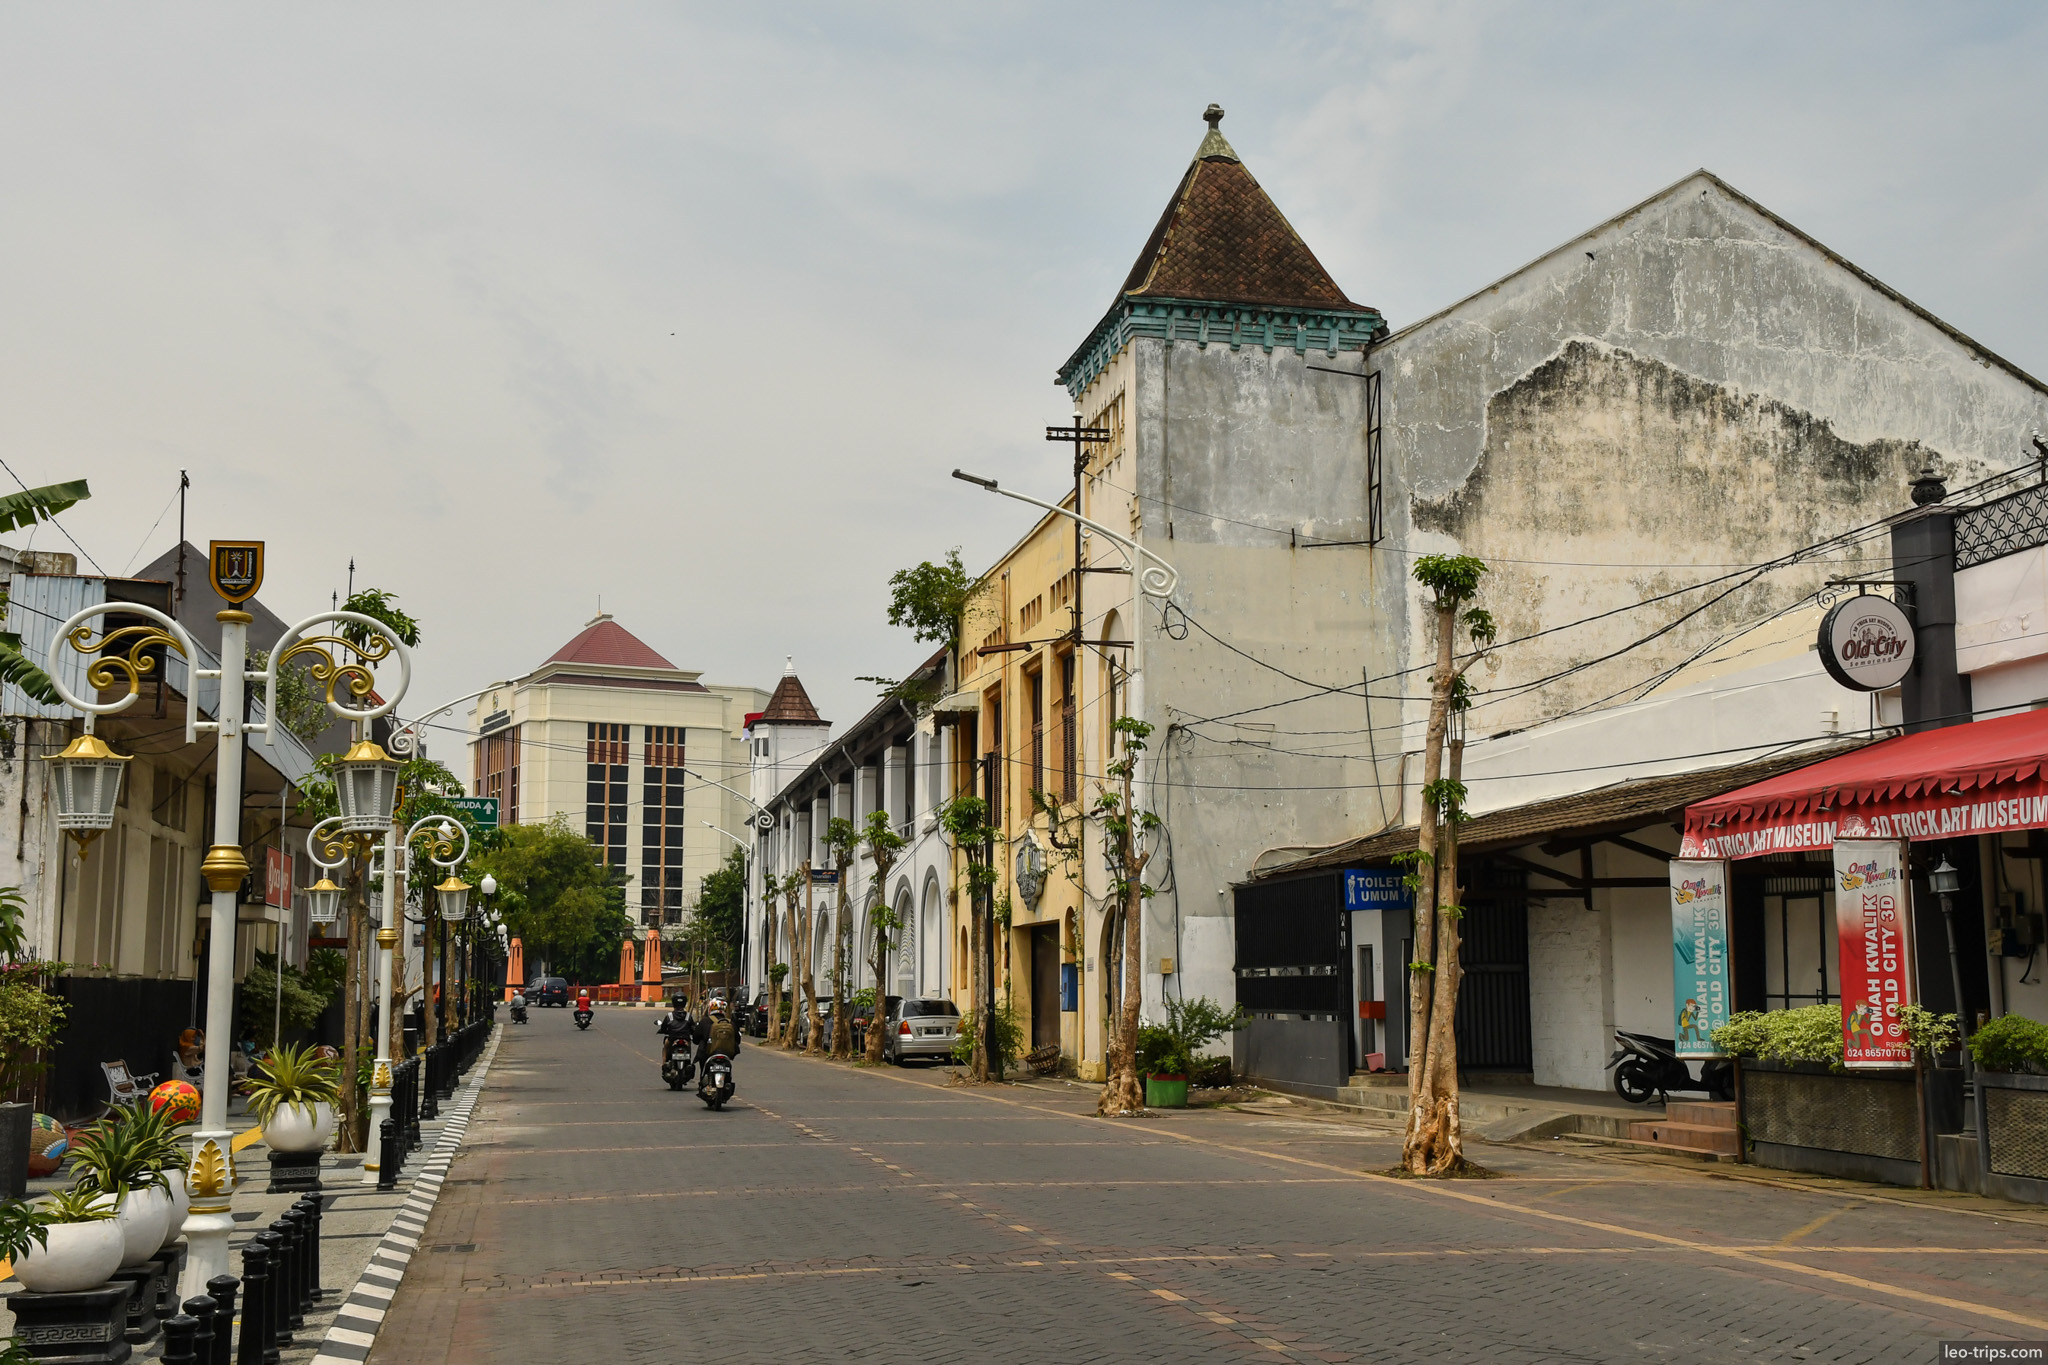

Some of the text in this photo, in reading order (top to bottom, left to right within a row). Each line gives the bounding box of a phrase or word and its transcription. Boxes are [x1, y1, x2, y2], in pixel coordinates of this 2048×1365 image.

[1842, 636, 1907, 660] Old City
[1870, 815, 1891, 837] 3D
[1891, 809, 1938, 837] TRICK
[1941, 805, 1969, 833] ART
[1971, 795, 2048, 830] MUSEUM
[1700, 838, 1719, 858] 3D
[1716, 832, 1752, 858] TRICK
[1752, 828, 1773, 853] ART
[1773, 821, 1837, 849] MUSEUM
[1848, 860, 1878, 875] Omah
[1864, 867, 1897, 884] Kwalik
[1357, 876, 1401, 888] TOILET
[1681, 877, 1706, 891] Omah
[1695, 883, 1722, 899] Kwalik
[1361, 890, 1399, 901] UMUM
[1707, 908, 1720, 931] 3D
[1880, 895, 1896, 922] 3D
[1708, 935, 1721, 976] CITY
[1881, 926, 1897, 973] CITY
[1692, 907, 1709, 1031] OMAH KWALIK
[1863, 893, 1884, 1037] OMAH KWALIK
[1710, 980, 1723, 1015] OLD
[1884, 978, 1900, 1018] OLD
[1678, 1041, 1691, 1049] 024
[1847, 1048, 1907, 1057] 024 86570776
